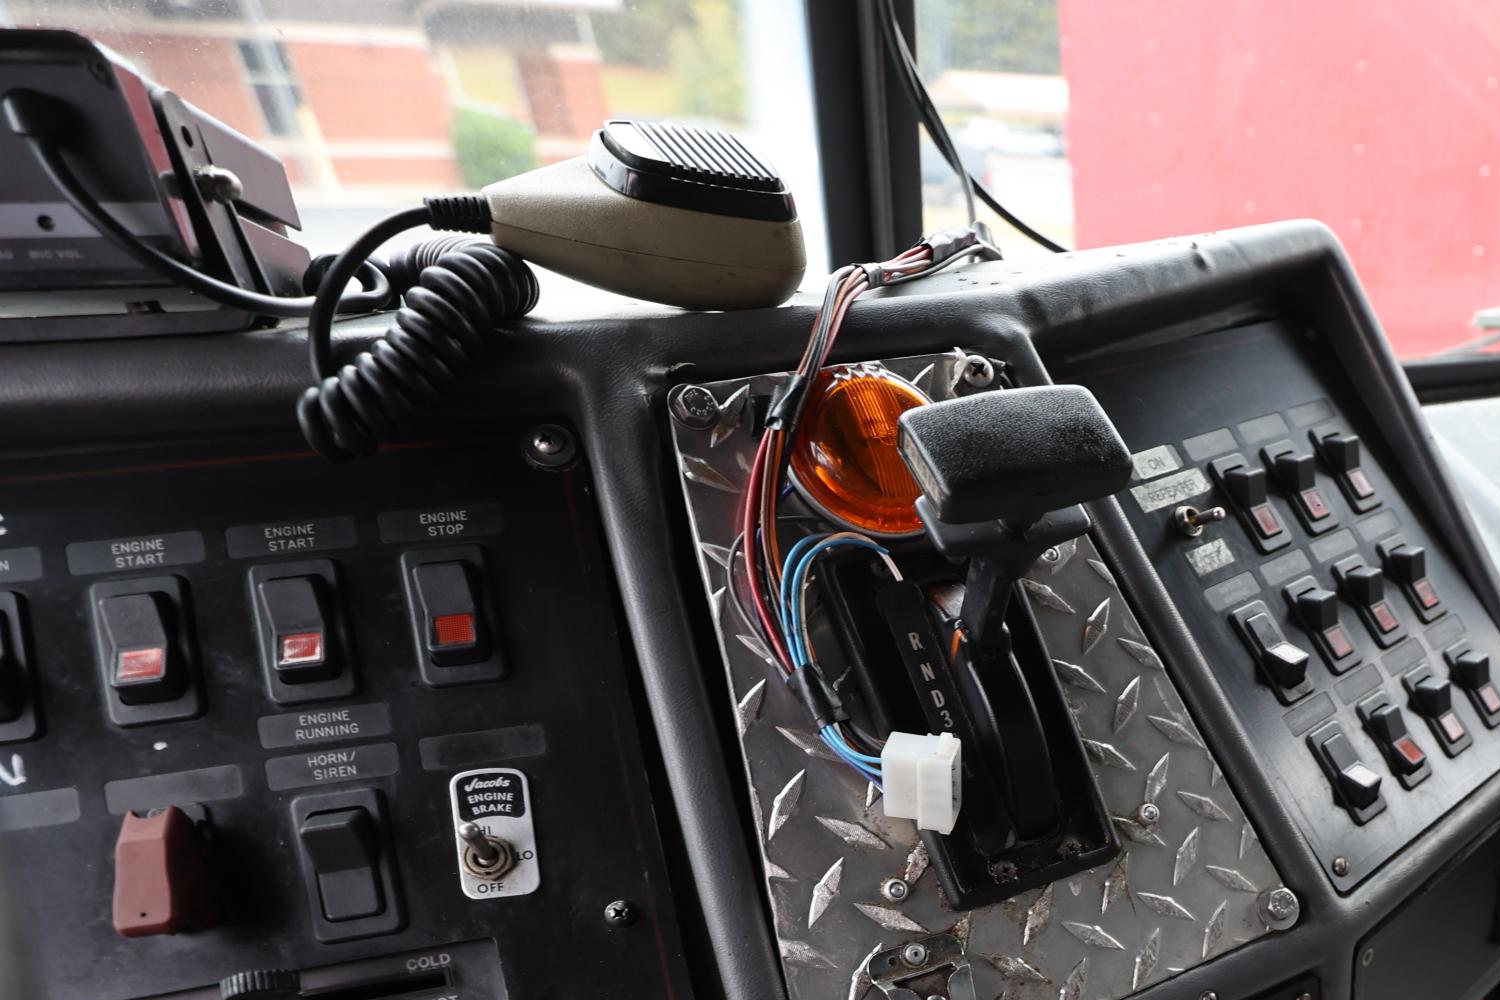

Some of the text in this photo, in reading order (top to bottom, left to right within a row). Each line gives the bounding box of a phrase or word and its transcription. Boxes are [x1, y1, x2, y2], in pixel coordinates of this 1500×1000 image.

[419, 510, 468, 525] ENGINE
[264, 523, 315, 539] ENGINE
[428, 523, 465, 537] STOP
[111, 537, 164, 556] ENGINE
[268, 536, 315, 552] START
[114, 551, 165, 569] START
[908, 632, 953, 728] R N D 3
[299, 710, 350, 726] ENGINE
[295, 723, 360, 740] RUNNING
[307, 750, 357, 768] HORN/
[313, 765, 358, 781] SIREN
[464, 776, 511, 793] Jacobs
[467, 792, 515, 805] ENGINE
[472, 803, 513, 816] BRAKE
[516, 850, 534, 861] LO
[477, 881, 505, 894] OFF
[405, 953, 451, 971] COLD
